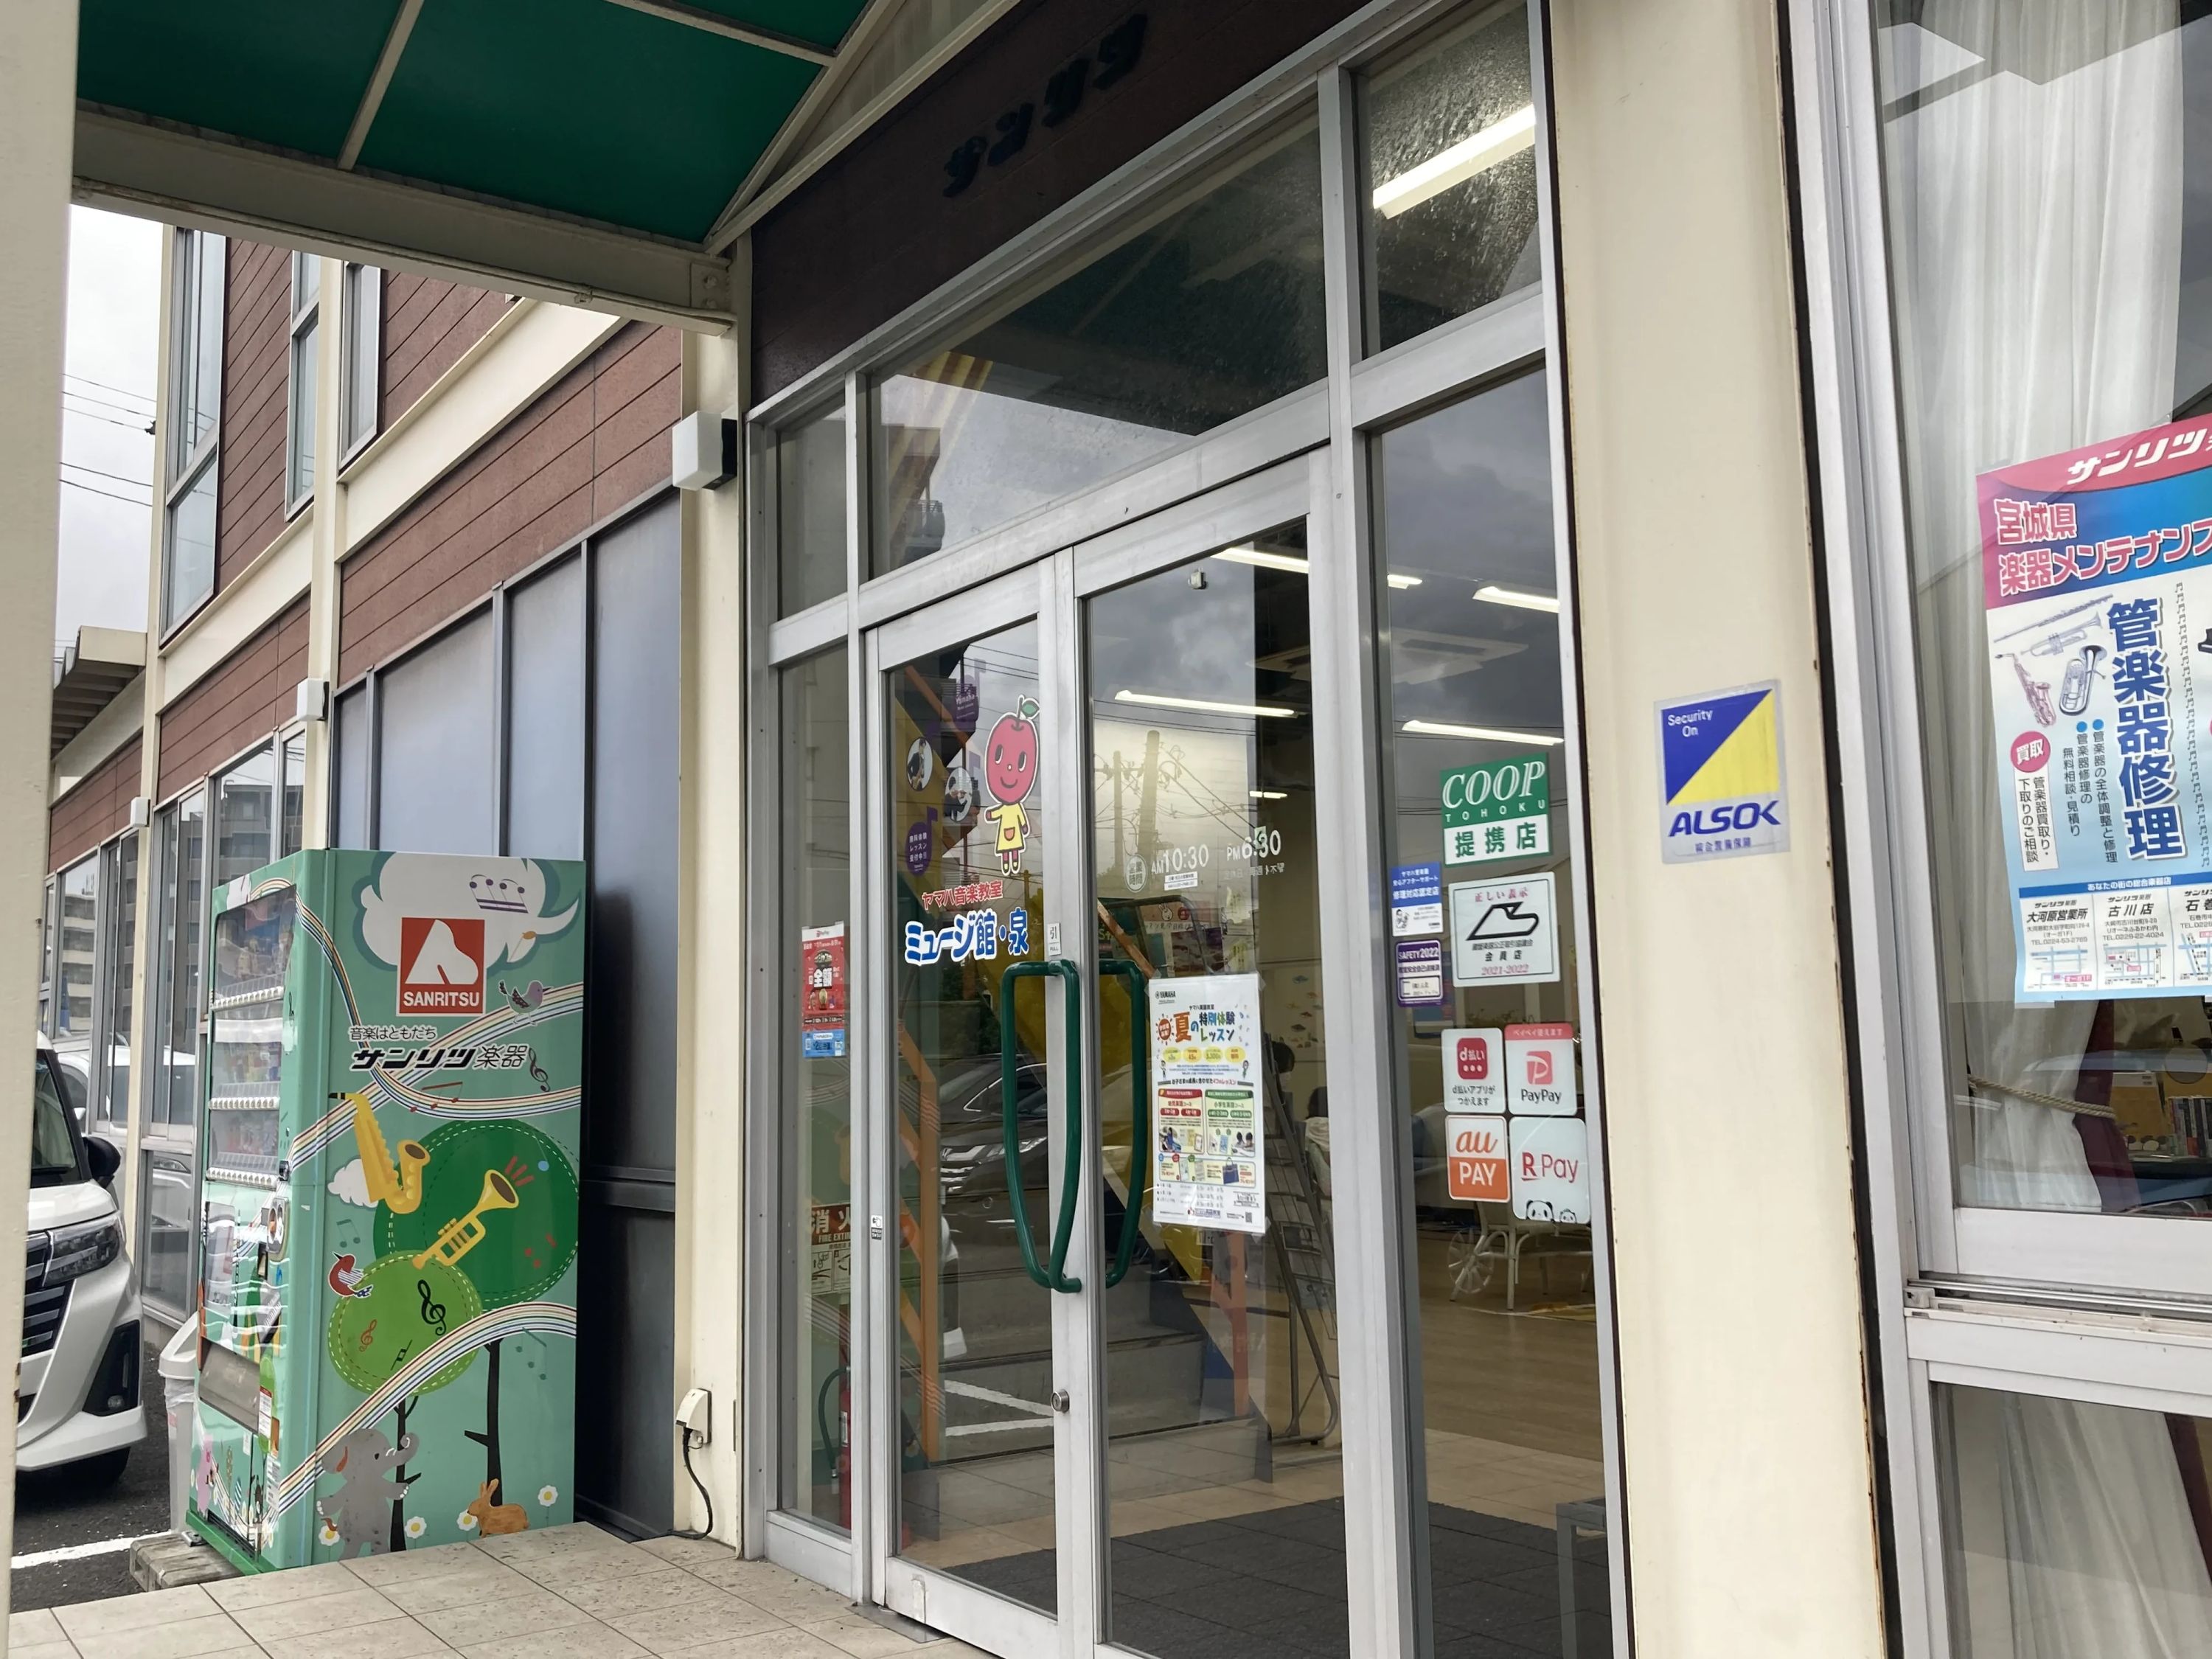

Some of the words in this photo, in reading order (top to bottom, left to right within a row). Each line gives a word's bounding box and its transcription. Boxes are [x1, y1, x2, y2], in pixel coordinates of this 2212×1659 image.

[2067, 428, 2212, 484] サンリツ
[1994, 498, 2077, 545] 宮城県
[1668, 709, 1713, 726] Security
[2107, 597, 2185, 859] 管楽器修理
[1682, 726, 1698, 737] On
[2016, 739, 2045, 765] 買取
[2076, 733, 2093, 804] 管楽器修理の
[1442, 761, 1545, 809] COOP
[2093, 731, 2118, 863] 管楽器の全体調整と修理
[1669, 800, 1781, 837] ALSOK
[2018, 778, 2039, 863] 下取りのご相談
[1455, 822, 1537, 858] 提携店
[922, 880, 1004, 911] ヤマハ音楽教室
[2184, 888, 2212, 897] サンリ
[2026, 908, 2088, 923] 大河原営業所
[2108, 902, 2154, 917] 古川店
[1485, 950, 1523, 962] 会員店
[1481, 964, 1529, 975] 2021-2022
[403, 992, 480, 1007] SANRITSU
[349, 1026, 437, 1041] 音楽はともだち
[1173, 1012, 1199, 1043] 夏の
[1199, 1011, 1236, 1026] 特別体験
[1200, 1029, 1235, 1043] レッスン
[350, 1045, 529, 1071] サンリツ楽器
[1459, 1047, 1485, 1062] d払い
[1453, 1085, 1495, 1095] d払いアプリが
[1458, 1096, 1489, 1106] つかえます
[1521, 1088, 1562, 1105] PayPay
[1455, 1131, 1498, 1153] au
[1459, 1162, 1497, 1186] PAY
[1541, 1154, 1578, 1183] Pay
